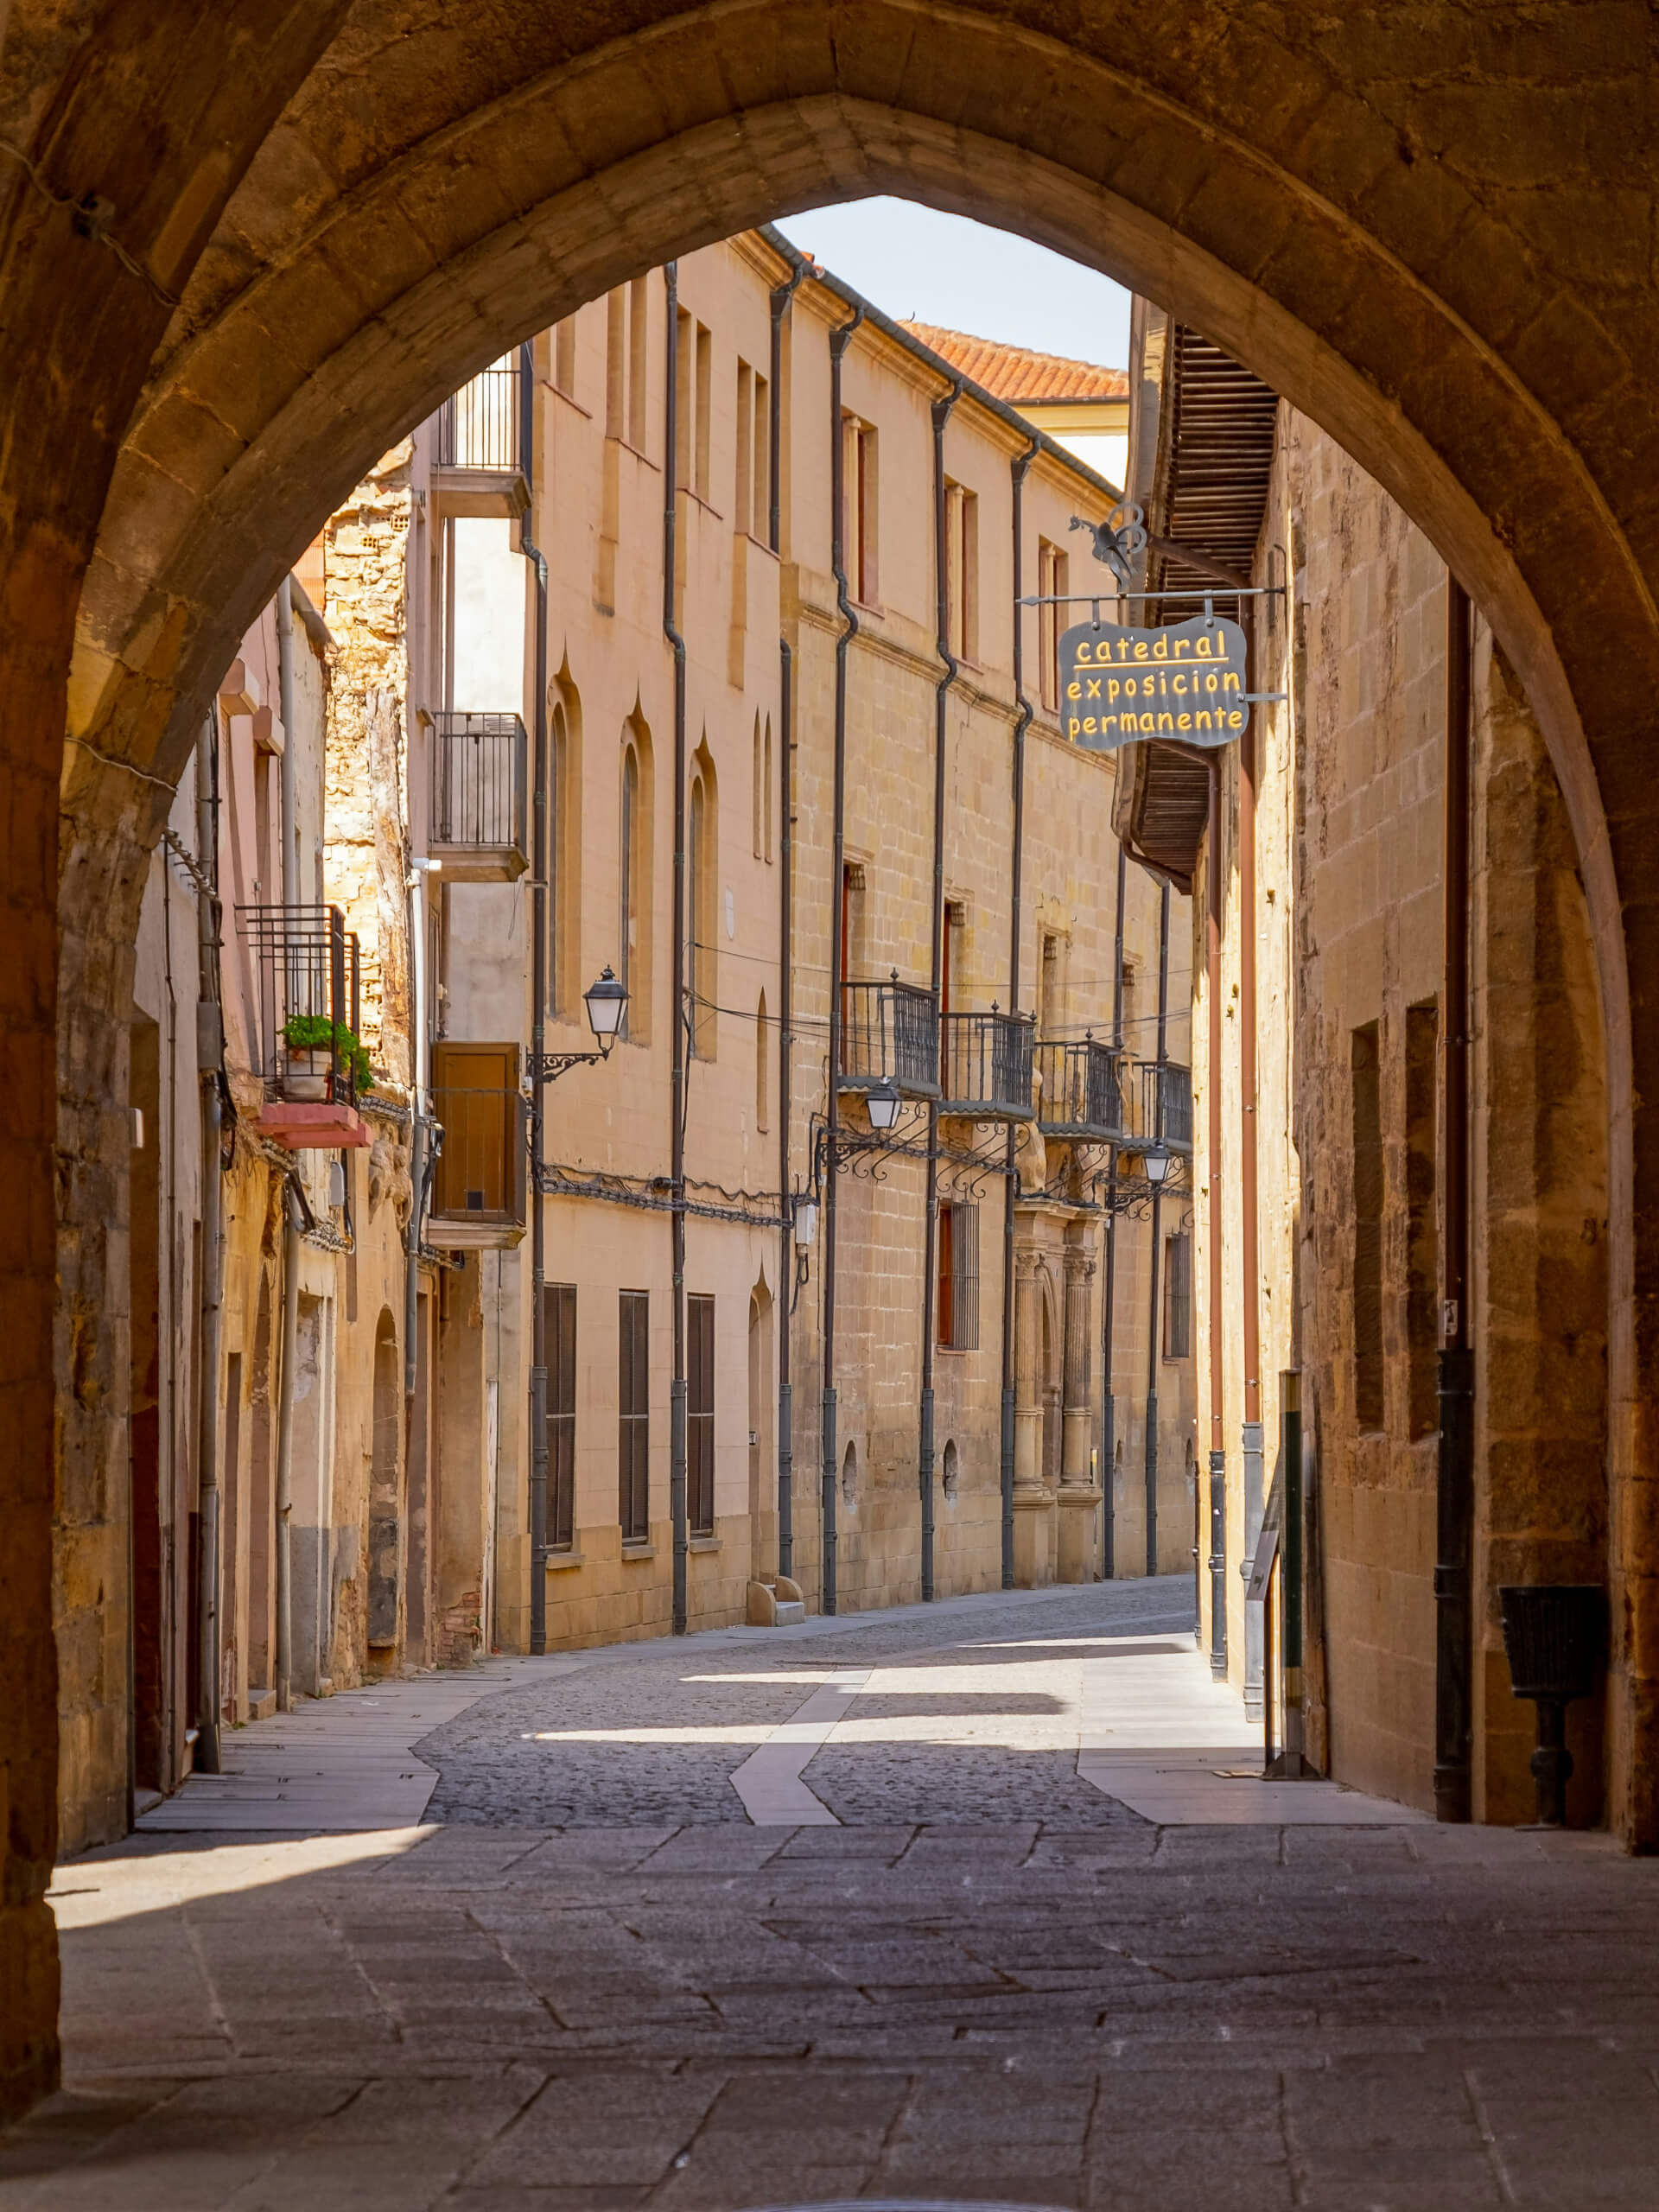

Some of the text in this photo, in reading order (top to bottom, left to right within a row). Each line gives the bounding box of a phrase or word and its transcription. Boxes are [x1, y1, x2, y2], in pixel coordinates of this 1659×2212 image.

[1076, 630, 1225, 663] catedral
[1067, 668, 1241, 704] exposición
[1069, 706, 1243, 741] permanente
